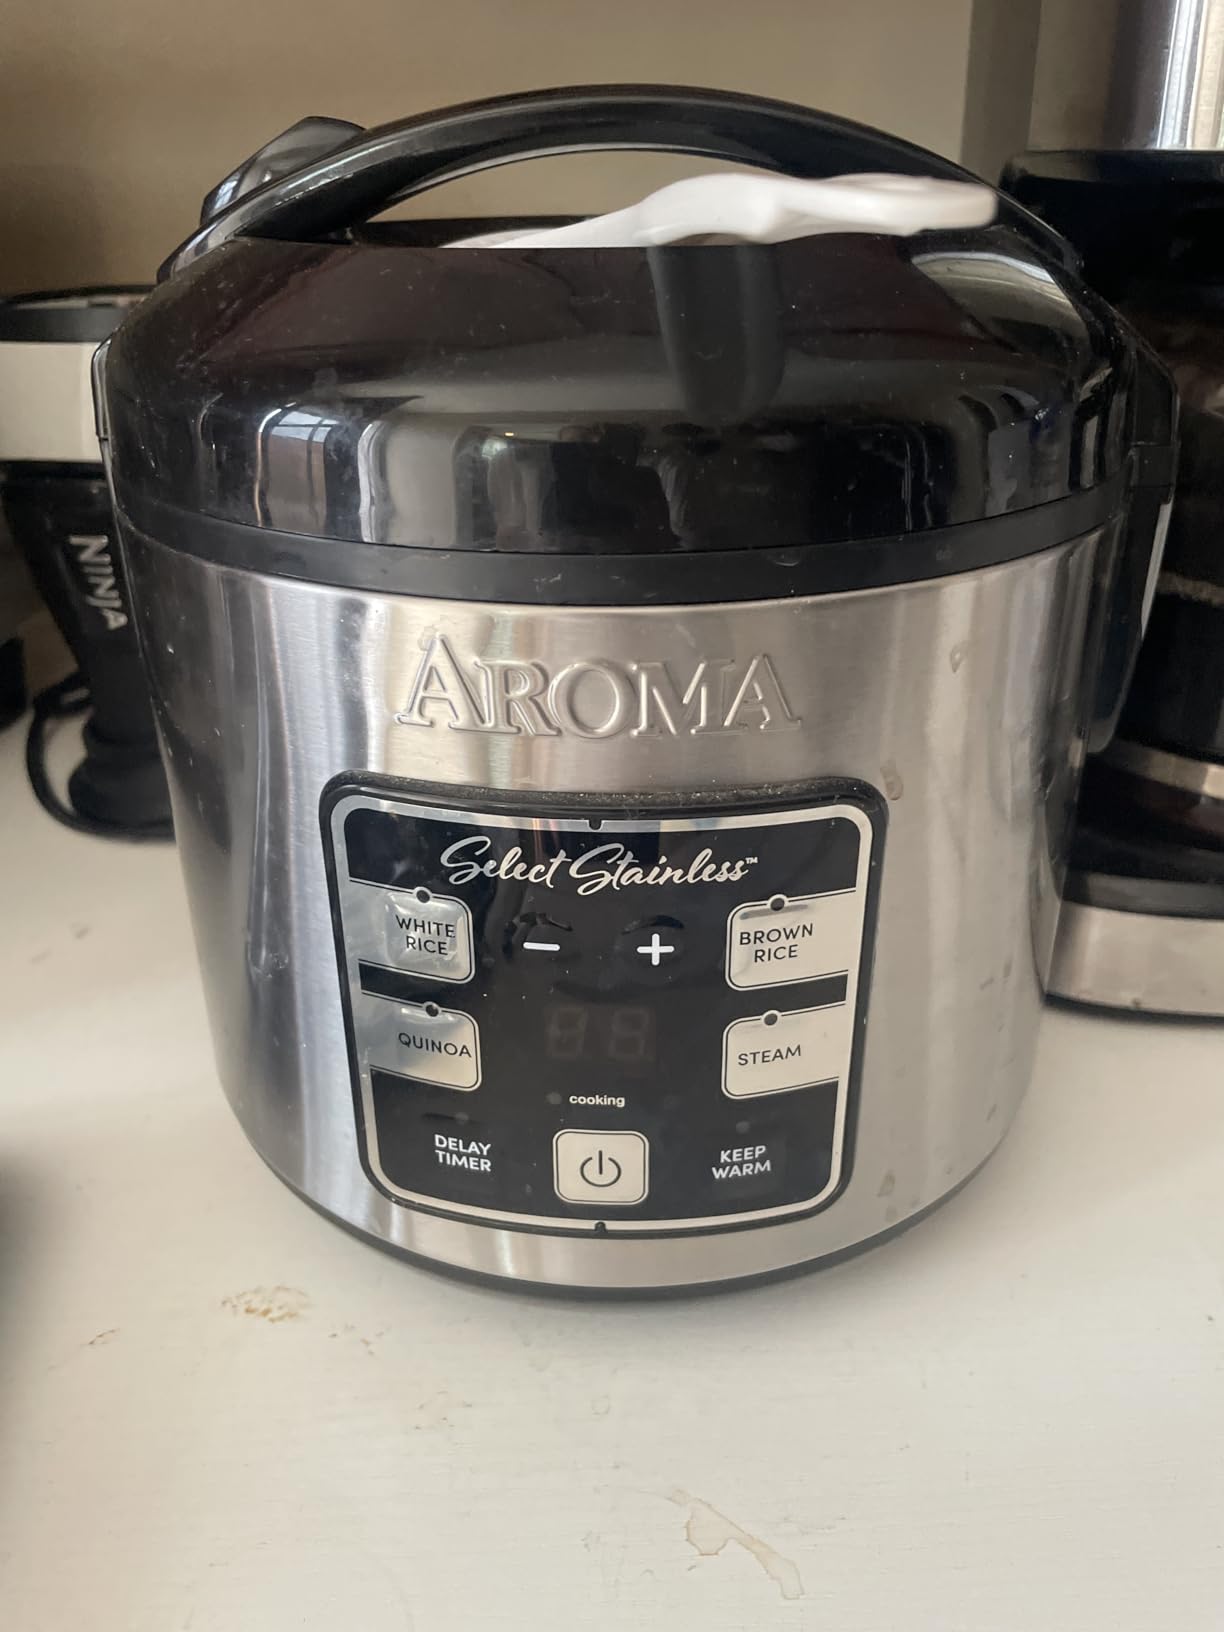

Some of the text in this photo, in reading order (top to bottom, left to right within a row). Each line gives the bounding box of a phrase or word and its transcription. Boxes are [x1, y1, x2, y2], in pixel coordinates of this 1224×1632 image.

[67, 533, 128, 631] NINJA
[395, 632, 802, 740] AROMA
[440, 836, 570, 888] Select
[396, 914, 456, 939] WHITE
[739, 922, 814, 947] BROWN
[405, 935, 449, 956] RICE
[753, 943, 799, 963] RICE
[398, 1031, 472, 1058] QUINOA
[737, 1044, 802, 1067] STEAM
[569, 1094, 626, 1108] cooking
[434, 1133, 492, 1156] DELAY
[720, 1145, 767, 1164] KEEP
[435, 1150, 492, 1173] TIMER
[711, 1159, 772, 1180] WARM
